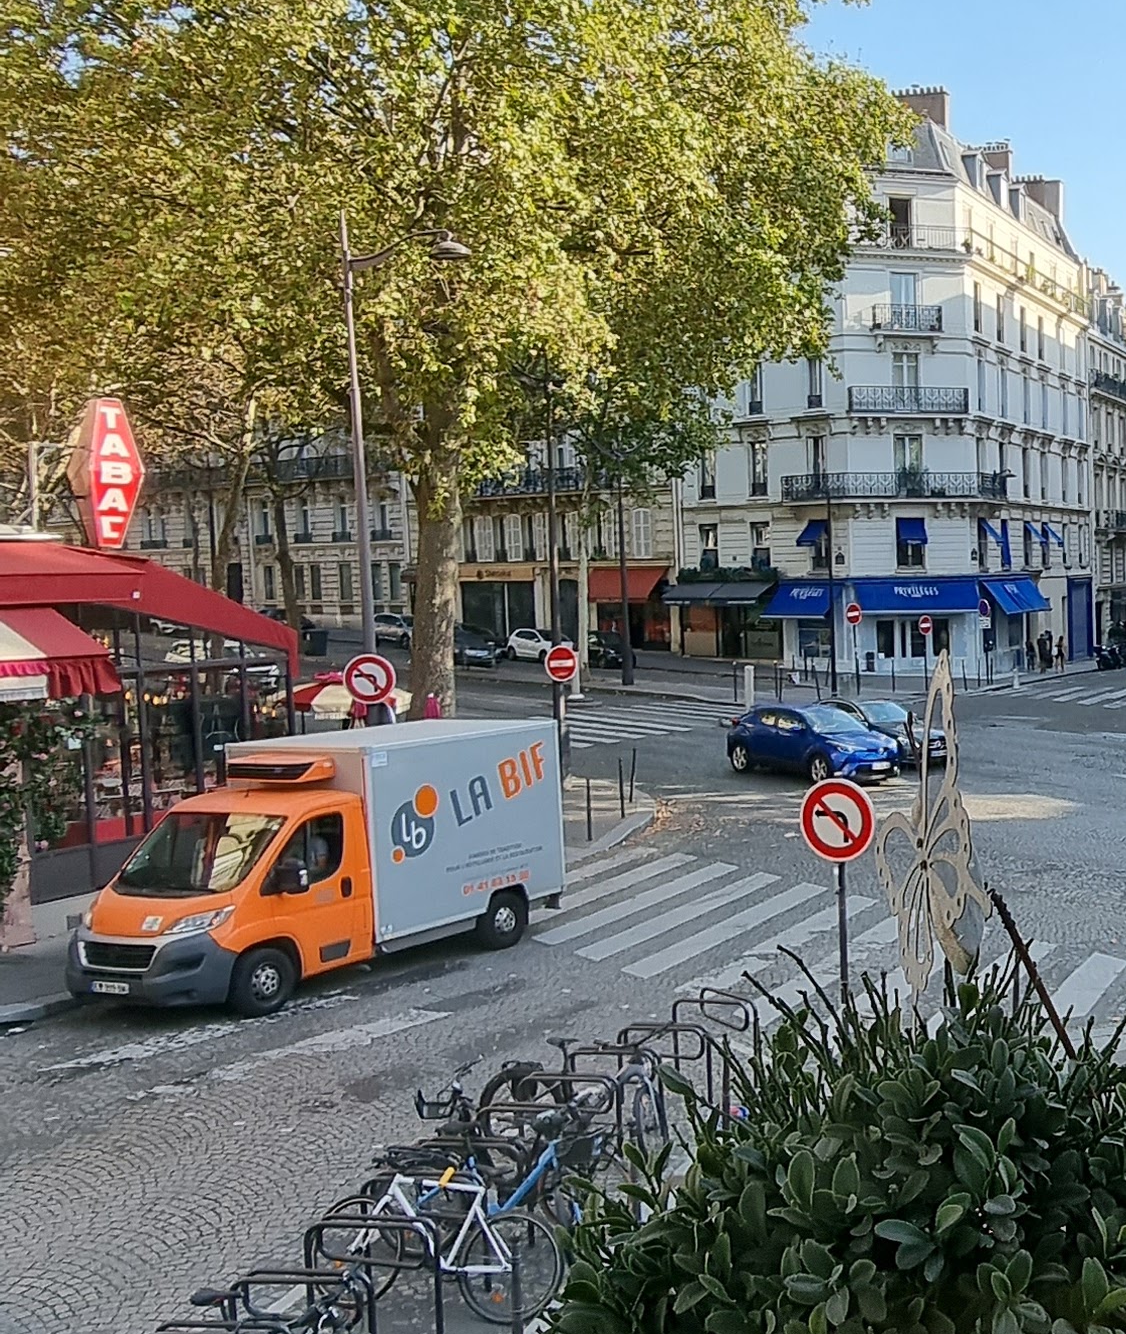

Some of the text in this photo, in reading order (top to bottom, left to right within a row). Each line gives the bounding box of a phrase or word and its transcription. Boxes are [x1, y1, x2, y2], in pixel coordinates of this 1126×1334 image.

[97, 406, 133, 539] TABAC
[450, 740, 544, 827] LA BIF
